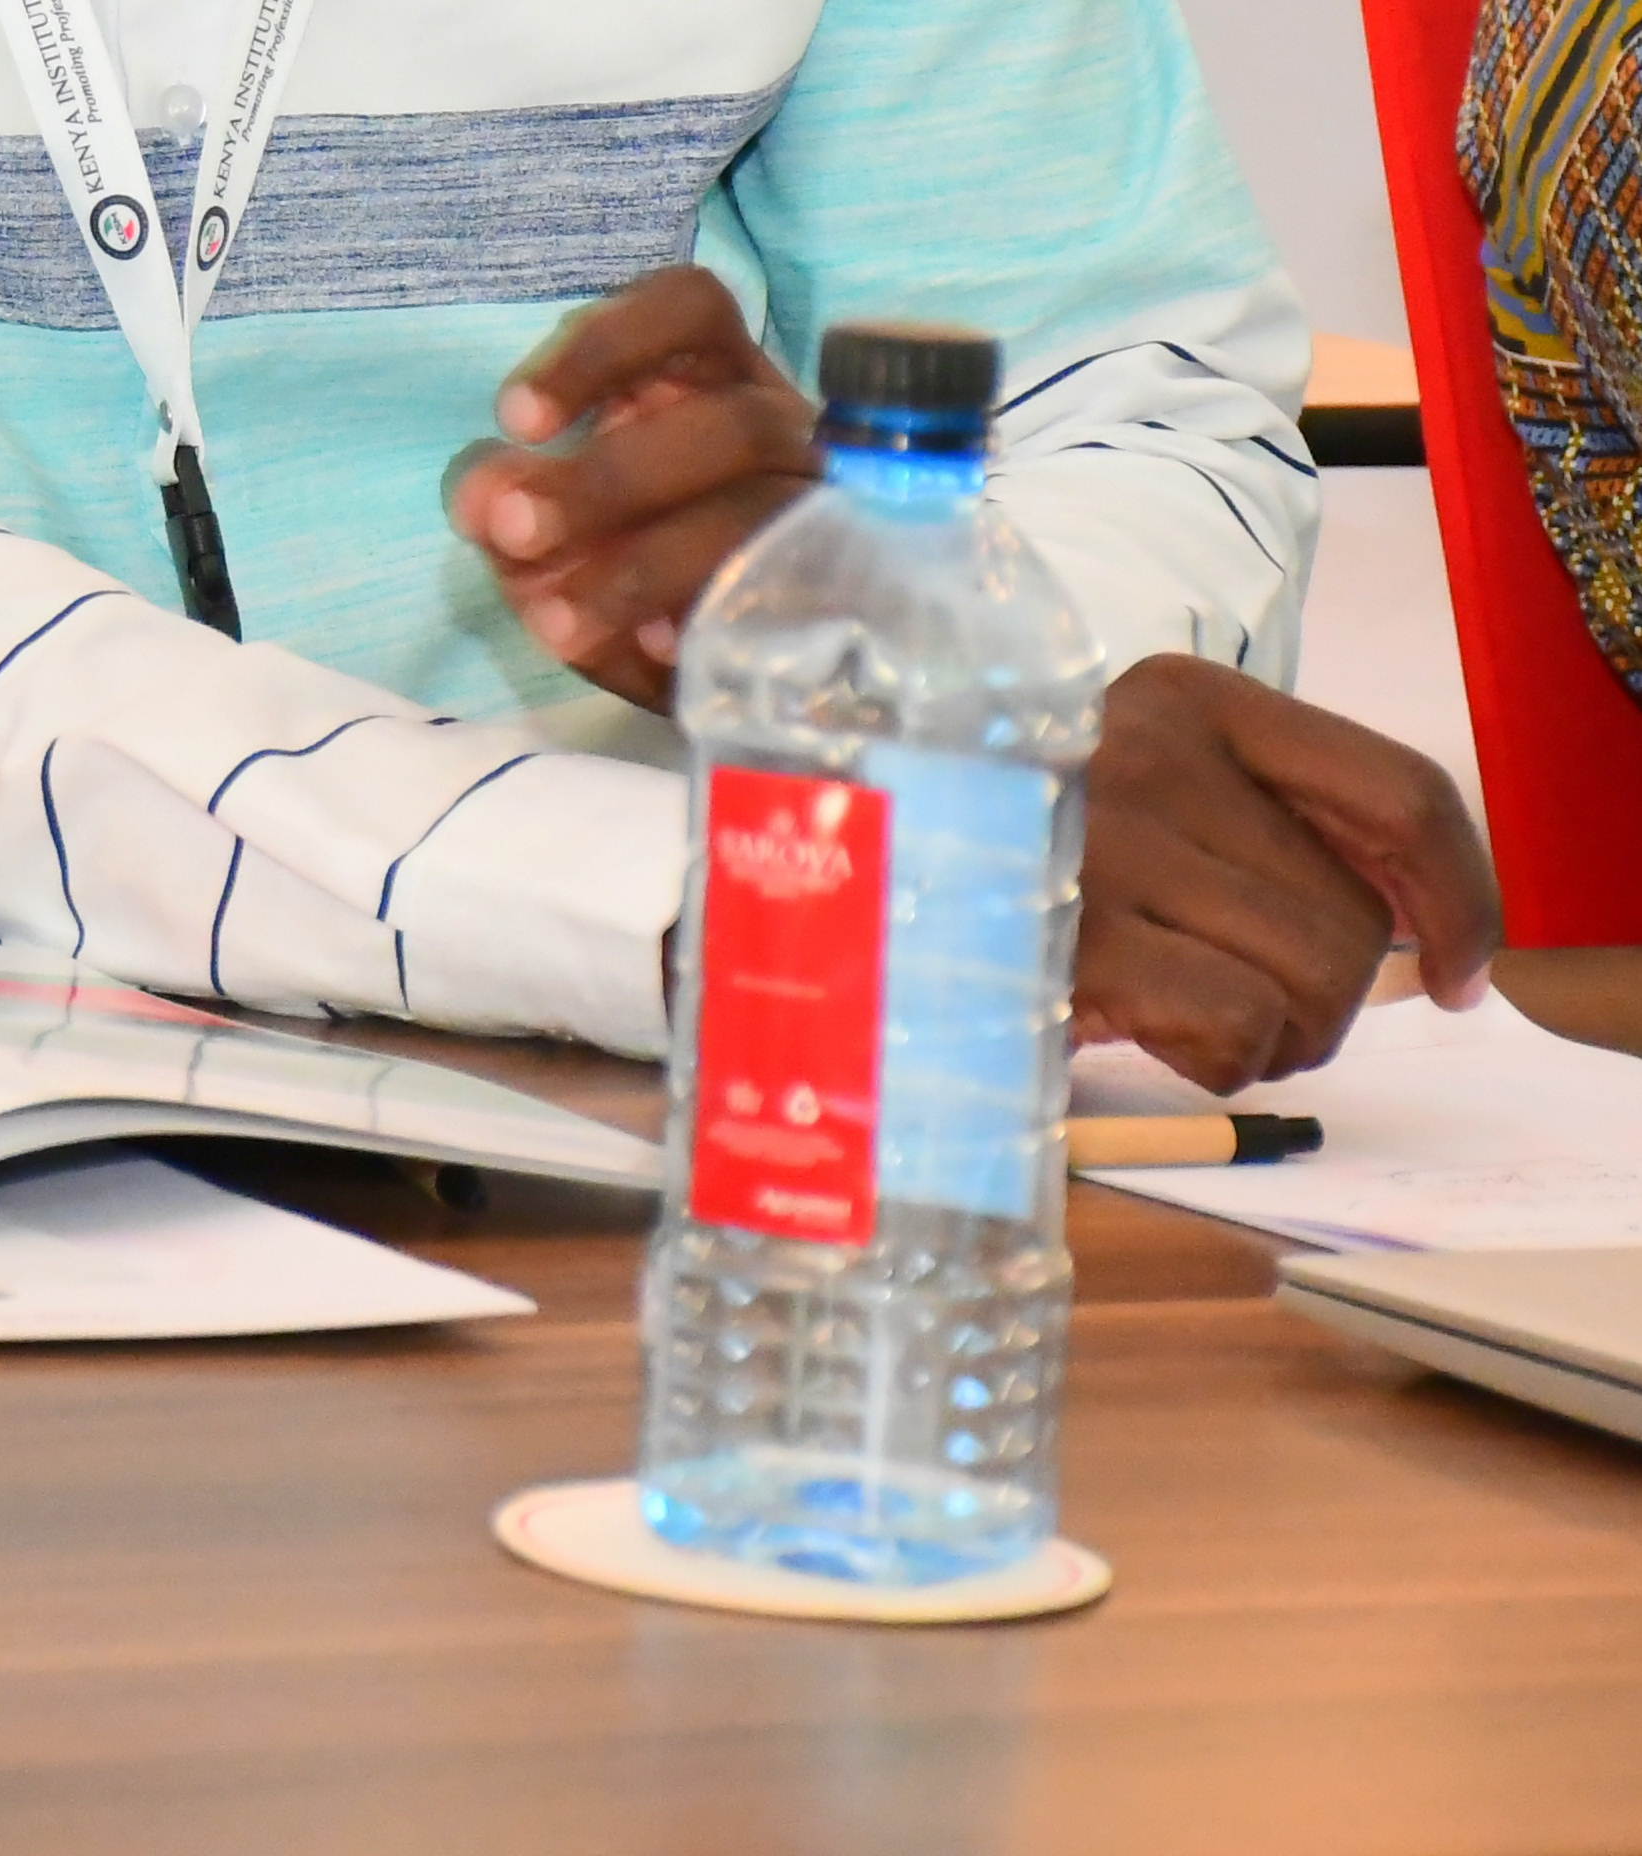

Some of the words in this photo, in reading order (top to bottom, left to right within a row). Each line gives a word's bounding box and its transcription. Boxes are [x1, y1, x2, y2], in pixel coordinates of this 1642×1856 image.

[67, 45, 103, 124] Promoting
[241, 64, 274, 143] Promoting
[64, 107, 105, 195] KENYA
[212, 116, 244, 200] KENYA
